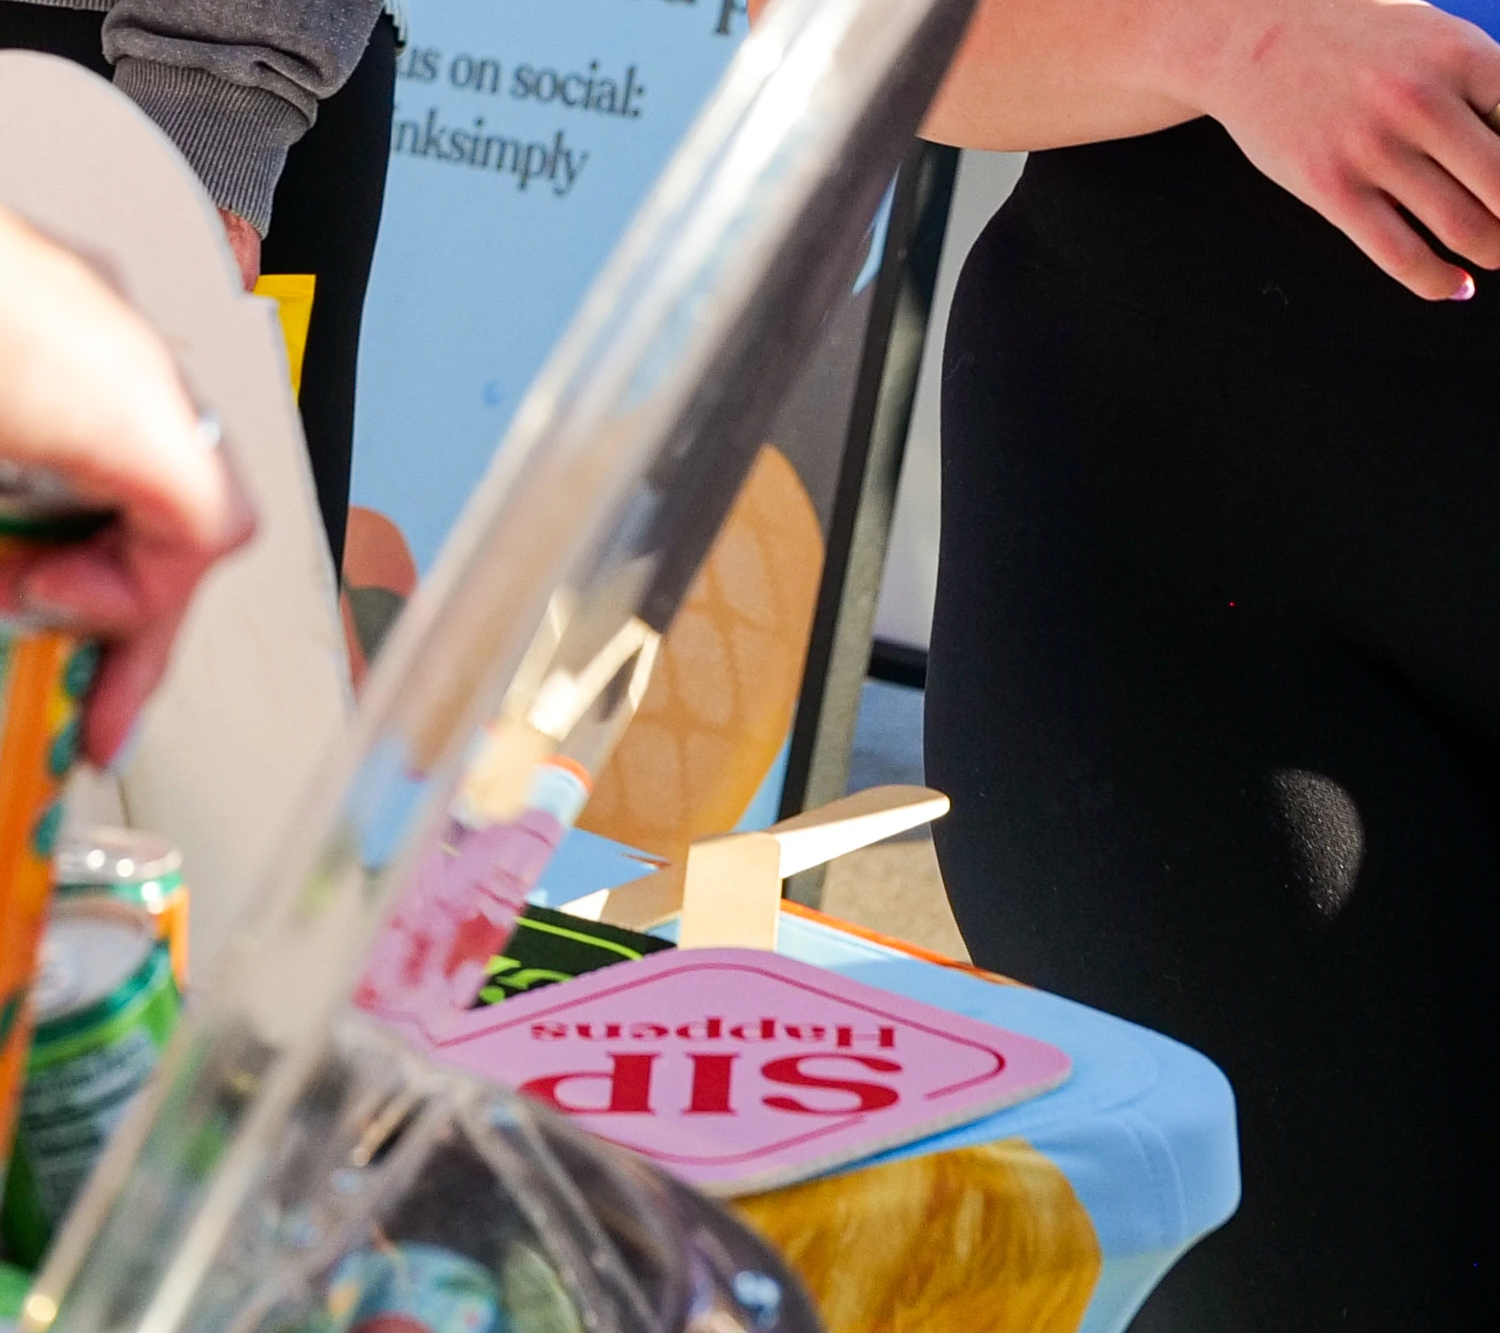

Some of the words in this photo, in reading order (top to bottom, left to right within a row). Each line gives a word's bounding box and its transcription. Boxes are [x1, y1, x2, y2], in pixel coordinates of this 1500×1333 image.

[449, 53, 500, 94] on
[511, 59, 645, 119] social:
[394, 106, 590, 197] nksimply
[530, 1016, 897, 1049] Happens
[517, 1051, 903, 1116] SIP
